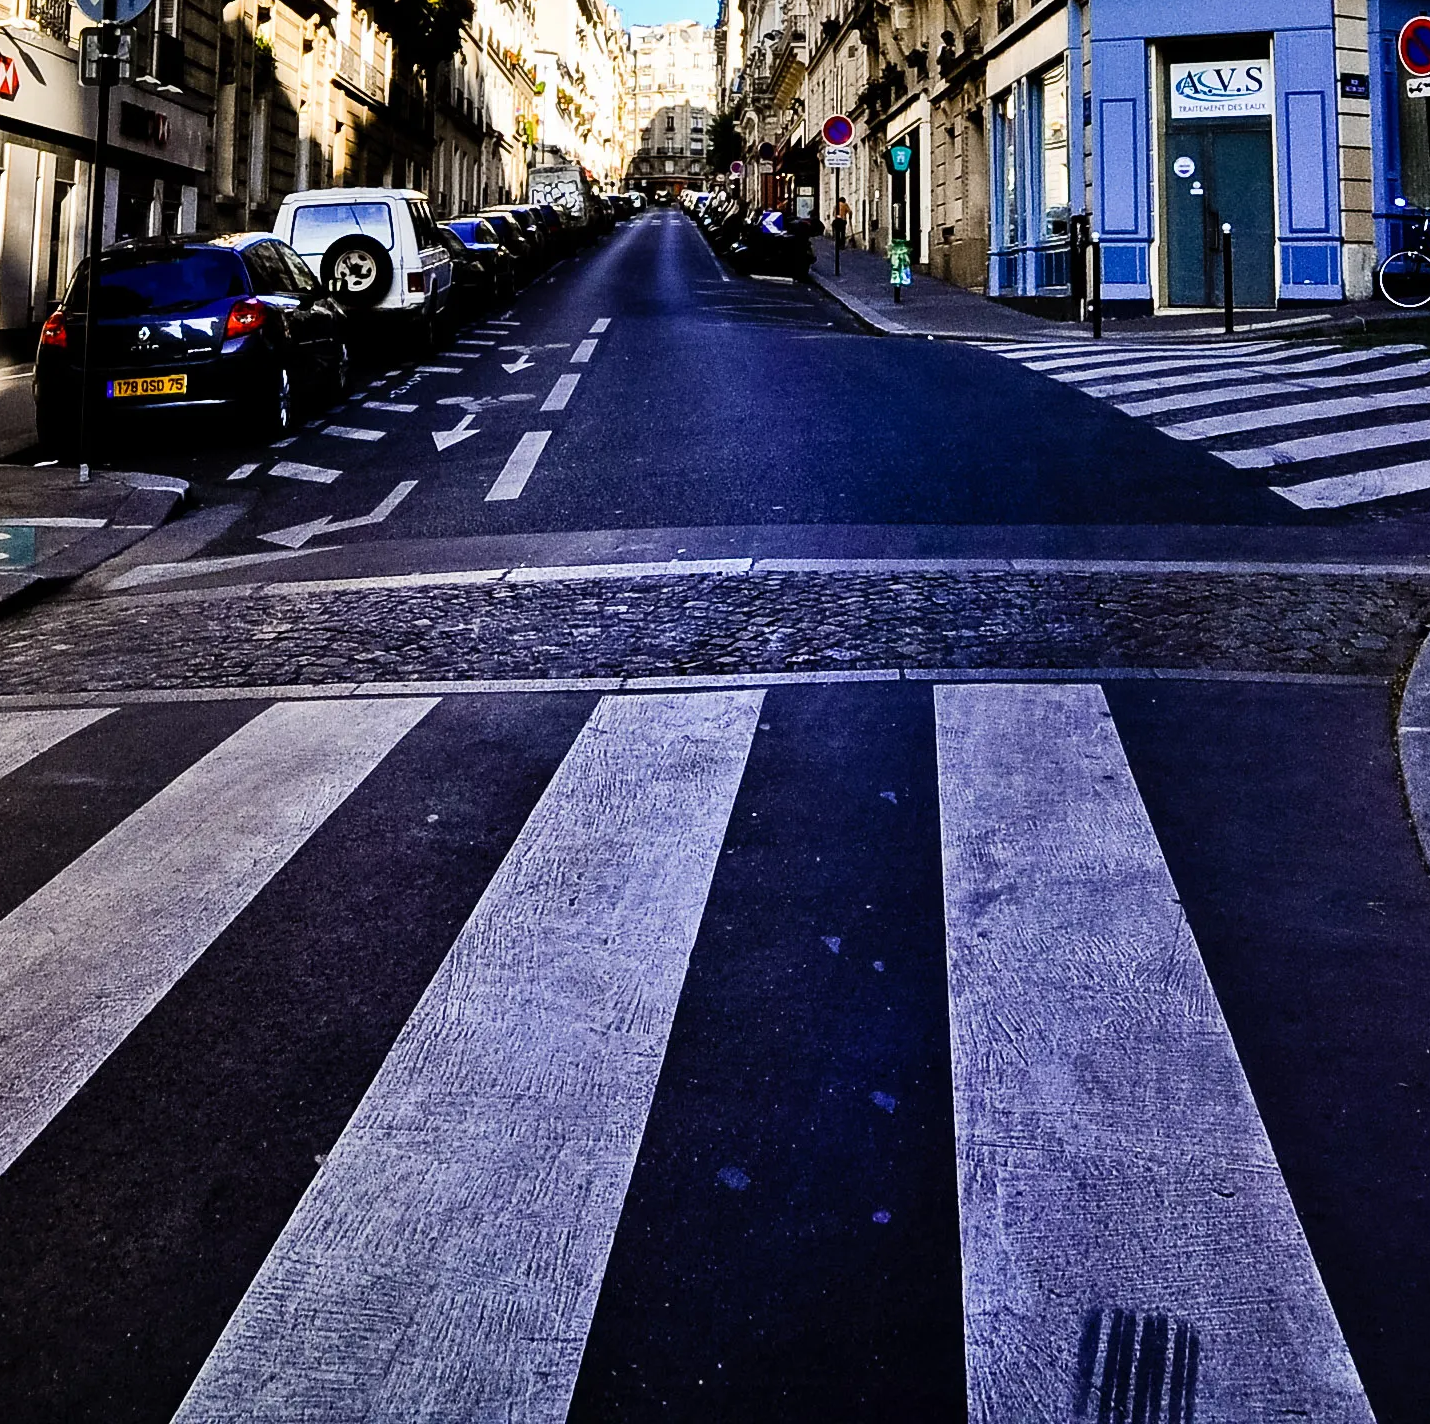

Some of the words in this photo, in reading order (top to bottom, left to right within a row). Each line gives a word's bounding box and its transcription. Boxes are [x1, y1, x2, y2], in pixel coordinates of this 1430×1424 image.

[1178, 66, 1263, 95] A.V.S
[1179, 104, 1225, 113] TRAITEMENT
[1227, 103, 1243, 112] DES
[1245, 102, 1266, 111] EAUX
[117, 380, 139, 395] 178
[167, 377, 184, 392] 75
